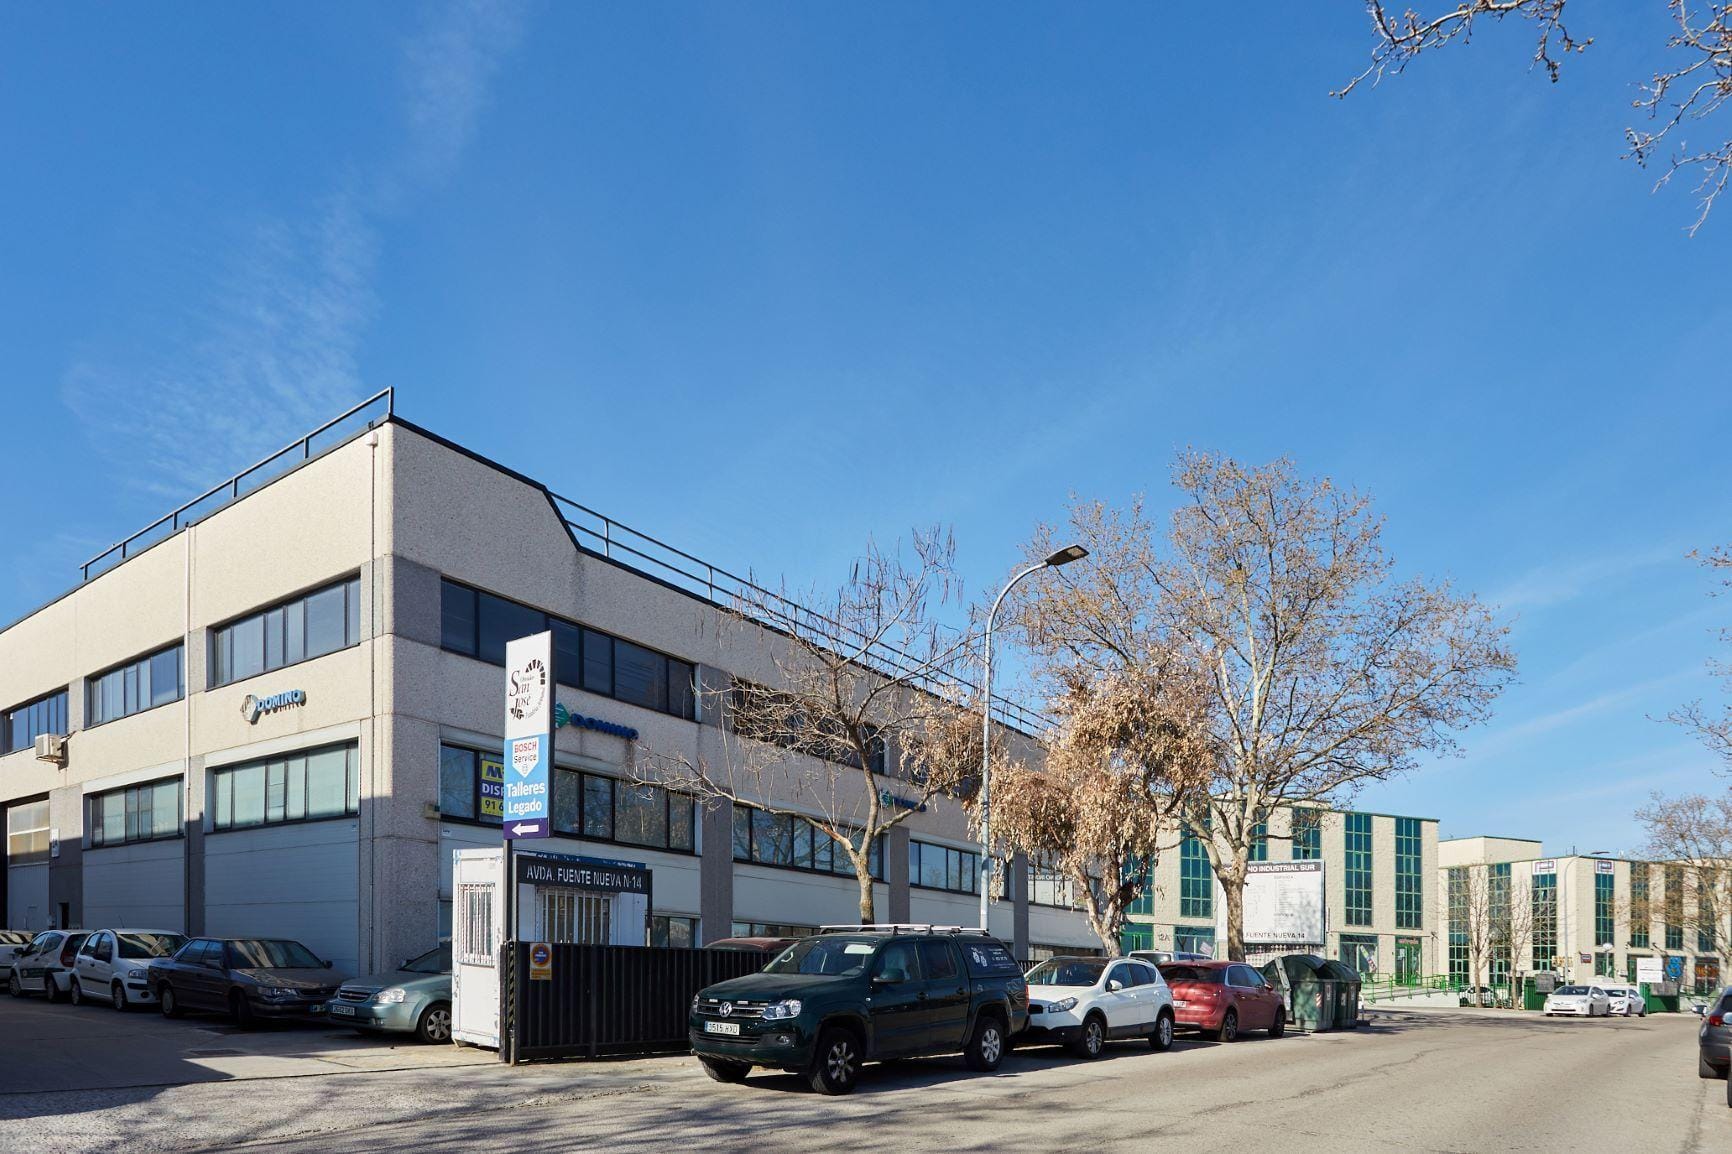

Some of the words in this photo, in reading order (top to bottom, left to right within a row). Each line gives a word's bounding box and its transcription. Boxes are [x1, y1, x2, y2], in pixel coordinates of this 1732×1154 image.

[256, 689, 303, 711] DOMINO
[514, 740, 537, 753] BOSCH
[513, 753, 537, 764] Service
[506, 781, 545, 798] Talleres
[508, 798, 542, 816] Legado
[526, 864, 555, 881] AVDA.
[557, 867, 591, 885] FUENTE
[593, 871, 621, 889] NUEVA
[1258, 865, 1299, 873] INDUSTRIAL
